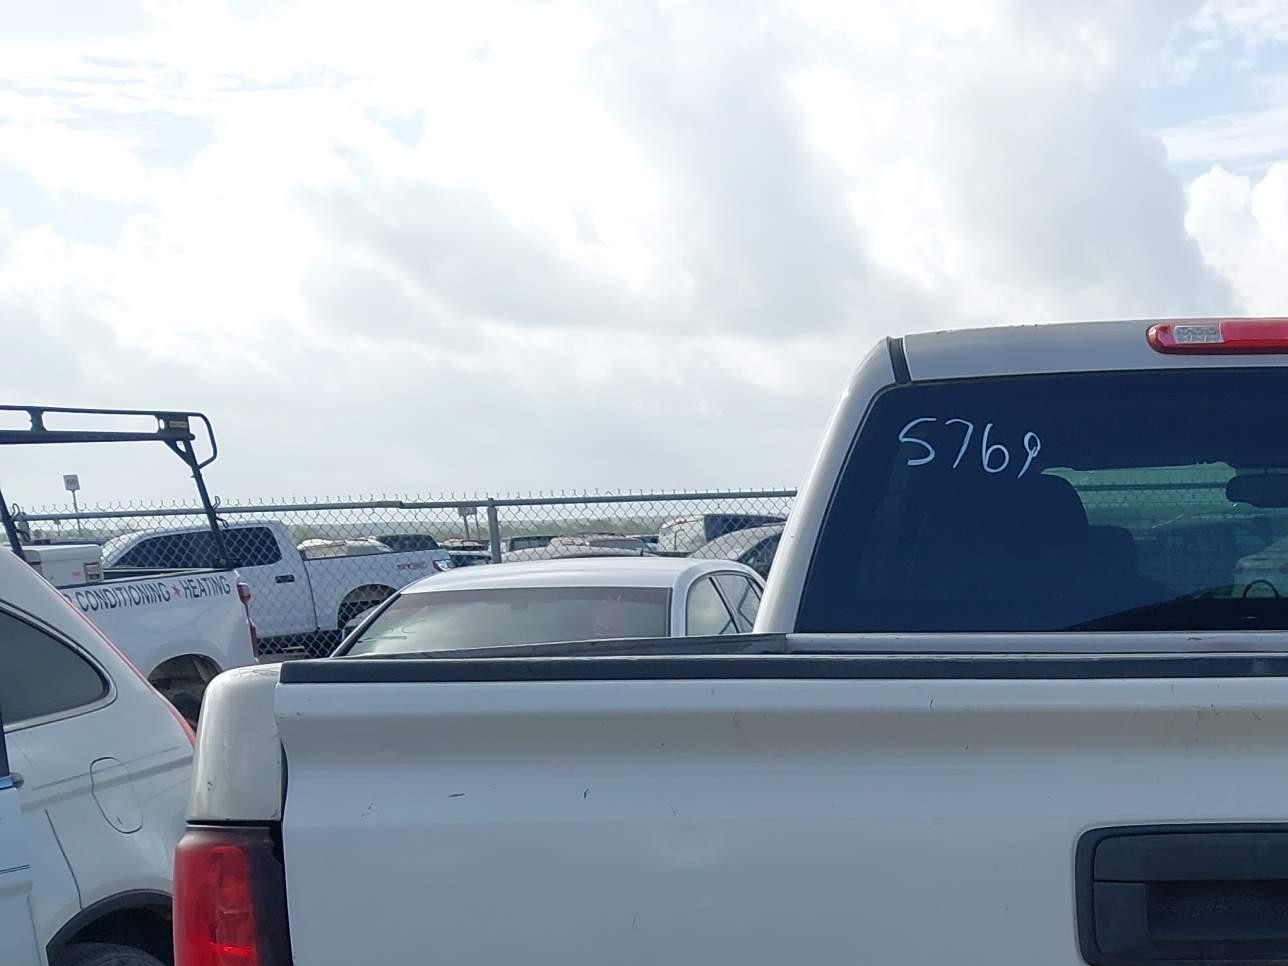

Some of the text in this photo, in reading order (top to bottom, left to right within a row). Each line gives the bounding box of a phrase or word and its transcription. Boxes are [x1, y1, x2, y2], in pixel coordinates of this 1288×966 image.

[898, 416, 1041, 480] 5769
[75, 575, 231, 612] CONDITIONING HEATING
